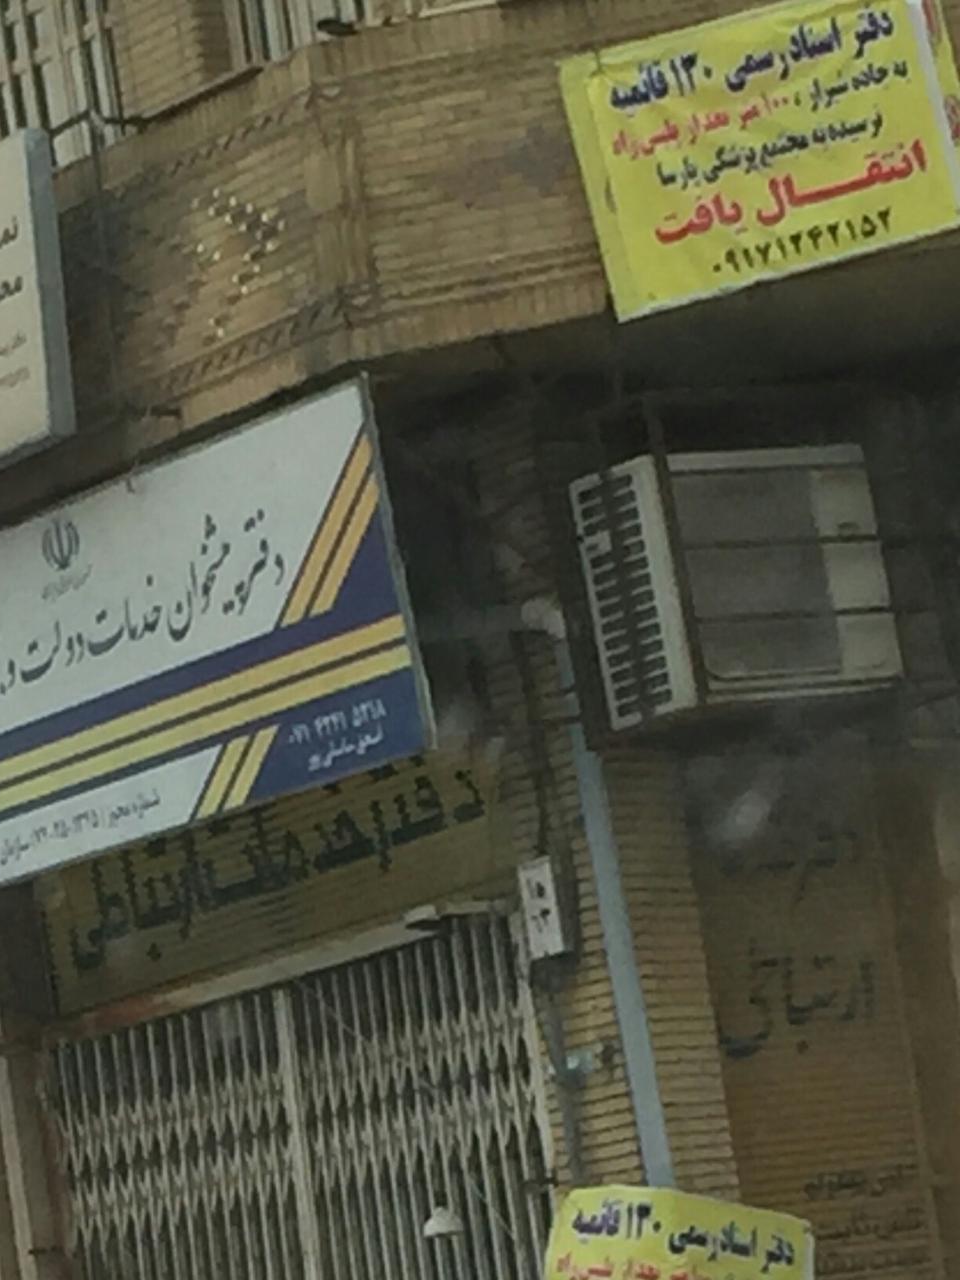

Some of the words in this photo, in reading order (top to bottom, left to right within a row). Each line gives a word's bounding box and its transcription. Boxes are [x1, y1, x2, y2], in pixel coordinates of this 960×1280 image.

[854, 4, 894, 59] دفتر
[725, 50, 789, 93] رسمی
[654, 191, 748, 244] یافت
[167, 513, 244, 642] پیشخوان
[238, 509, 285, 616] دفتر
[88, 574, 162, 656] خدمات
[20, 620, 84, 683] دولت
